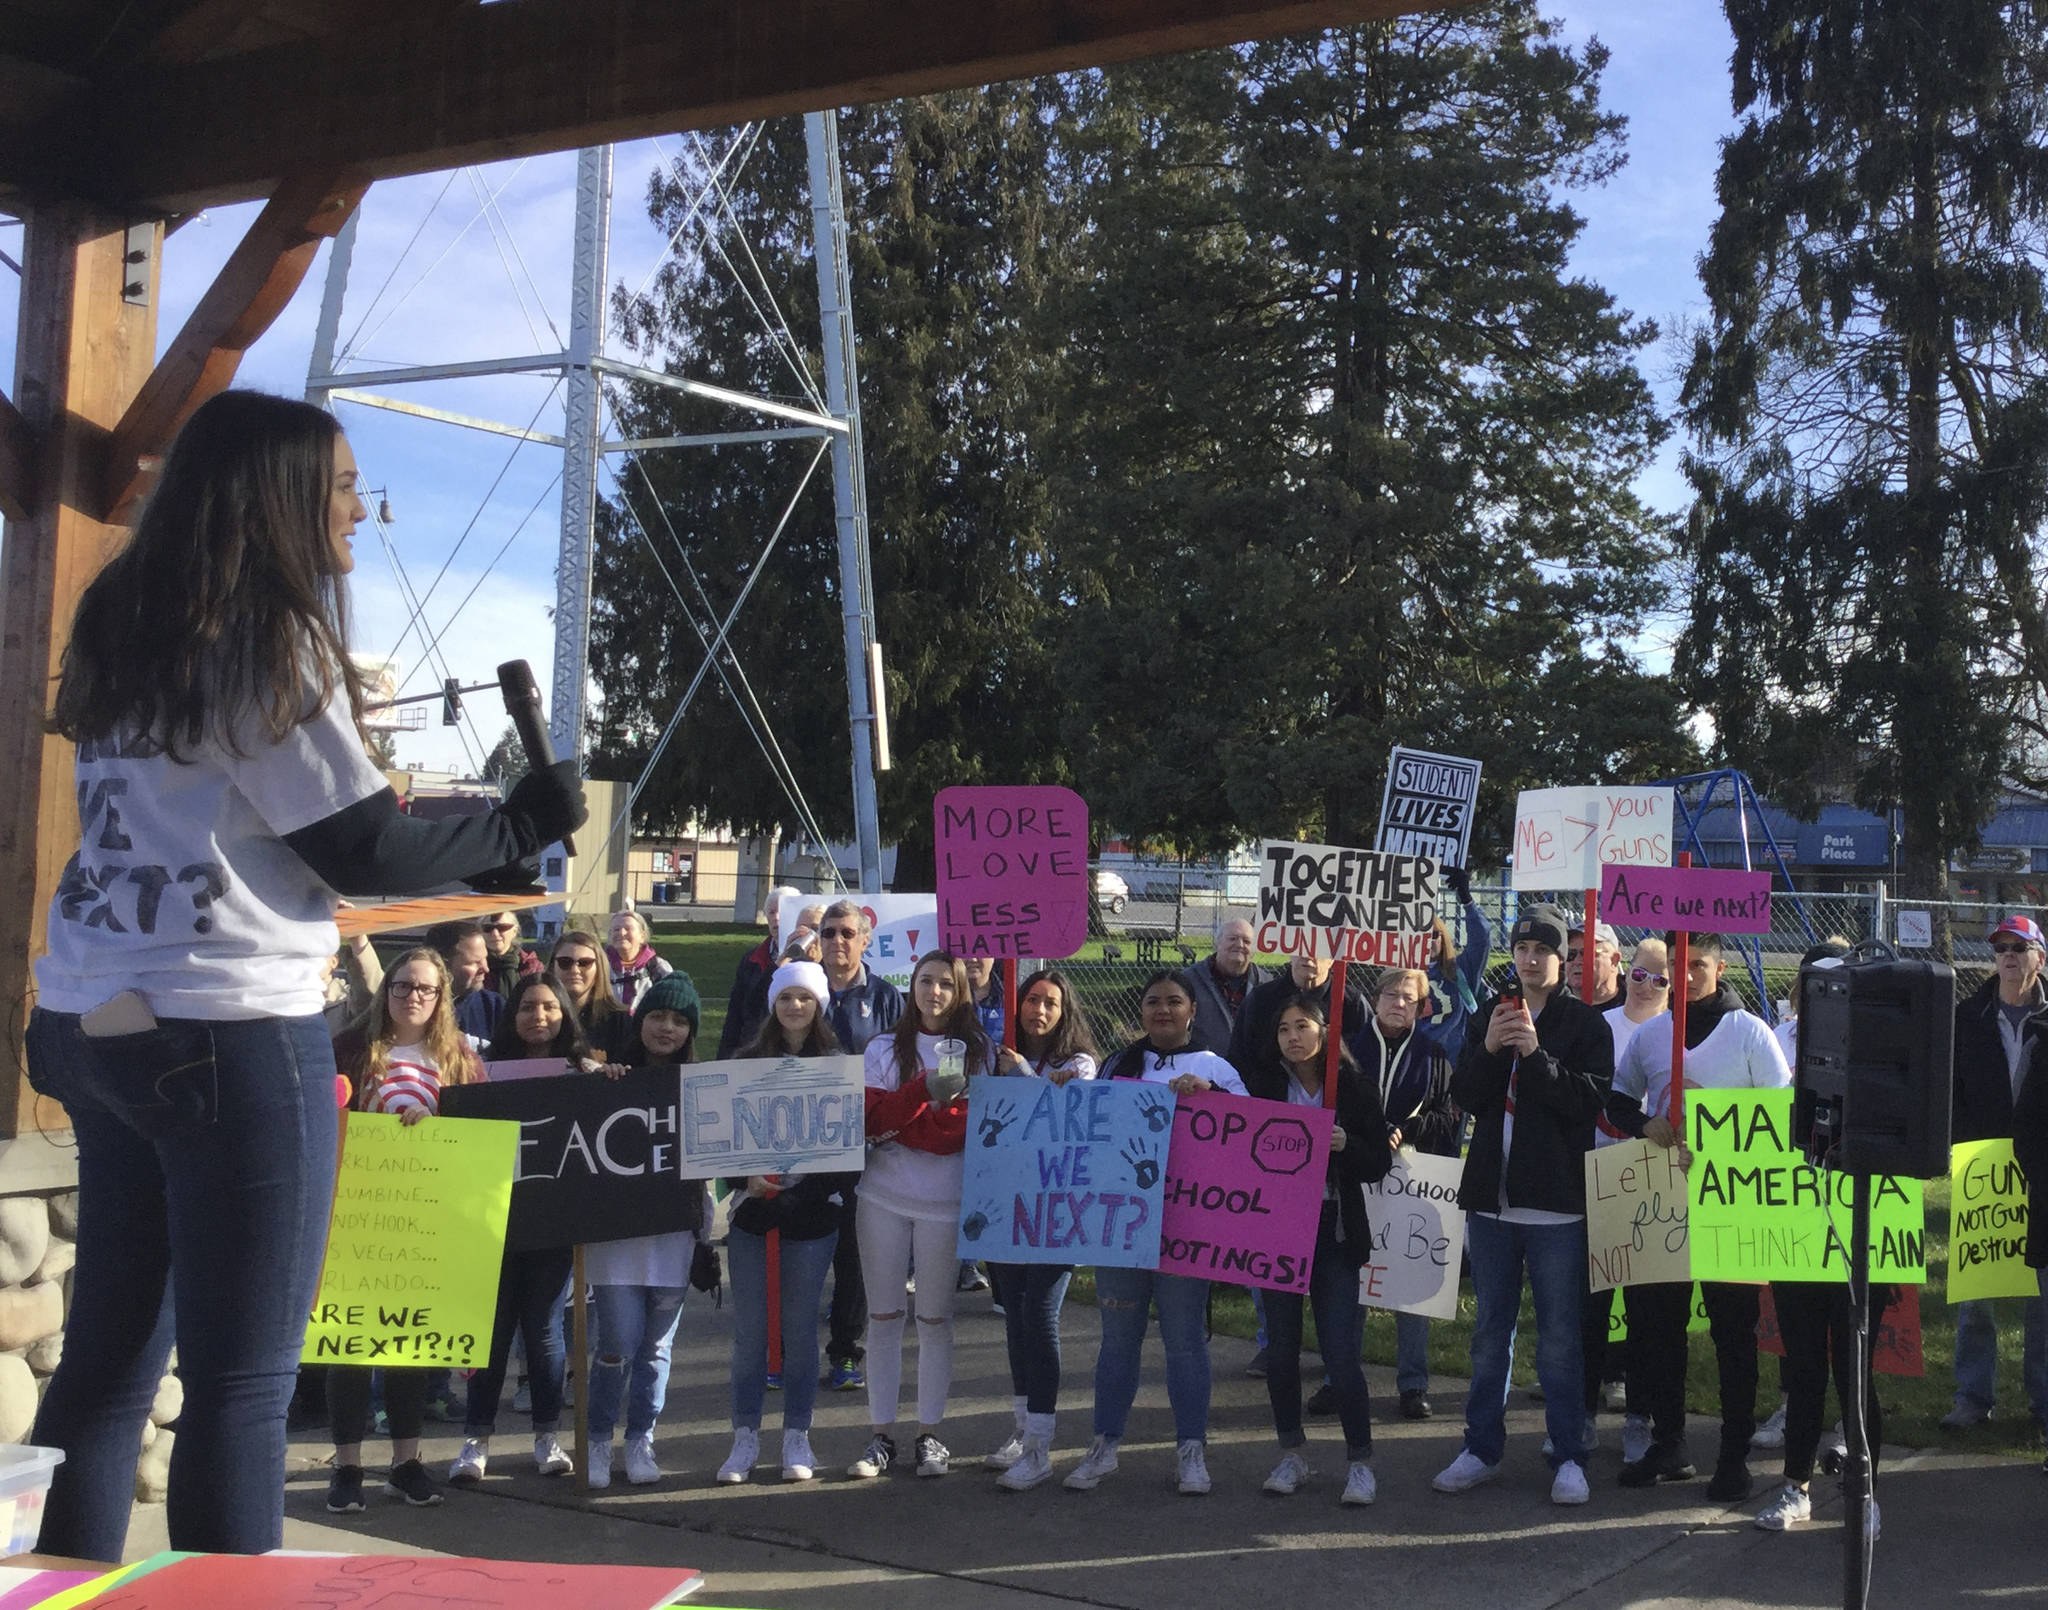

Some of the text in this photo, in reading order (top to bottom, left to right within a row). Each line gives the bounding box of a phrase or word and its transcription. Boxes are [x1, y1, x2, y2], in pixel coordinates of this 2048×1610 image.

[1397, 762, 1472, 798] STUDENT
[943, 804, 1073, 840] MORE
[1389, 798, 1463, 829] LIVES
[1384, 827, 1459, 867] MATTER
[1515, 818, 1556, 871] Me
[1606, 795, 1663, 831] your
[1599, 833, 1668, 864] Guns
[1823, 834, 1854, 847] Park
[946, 850, 1081, 880] LOVE
[1821, 847, 1856, 860] Place
[1266, 847, 1436, 900] TOGETHER
[946, 898, 1041, 927] LESS
[1261, 887, 1434, 933] WE CAN END
[1608, 873, 1771, 920] Are we next?
[946, 931, 1034, 955] HATE
[1256, 921, 1432, 970] GUN VIOLENCE
[683, 1073, 864, 1156] ENOUGH
[1022, 1084, 1112, 1143] ARE
[1174, 1104, 1247, 1145] OP
[1696, 1102, 1795, 1153] MA
[341, 1151, 439, 1173] RKLAND...
[1261, 1132, 1307, 1154] STOP
[1037, 1146, 1091, 1190] WE
[1386, 1165, 1460, 1203] SCHOO
[1593, 1143, 1658, 1201] Let
[336, 1185, 439, 1204] LUMBINE...
[1164, 1176, 1271, 1215] HOOL
[333, 1212, 369, 1229] NDY
[1012, 1191, 1151, 1251] NEXT?
[1402, 1213, 1451, 1266] Be
[1629, 1191, 1690, 1253] fly
[1955, 1203, 1991, 1239] NOT
[352, 1243, 438, 1263] VEGAS...
[1590, 1242, 1633, 1288] NOT
[1700, 1225, 1812, 1268] THINK
[1958, 1235, 2028, 1273] Destruc
[322, 1269, 441, 1292] RLANDO...
[378, 1305, 433, 1328] WE
